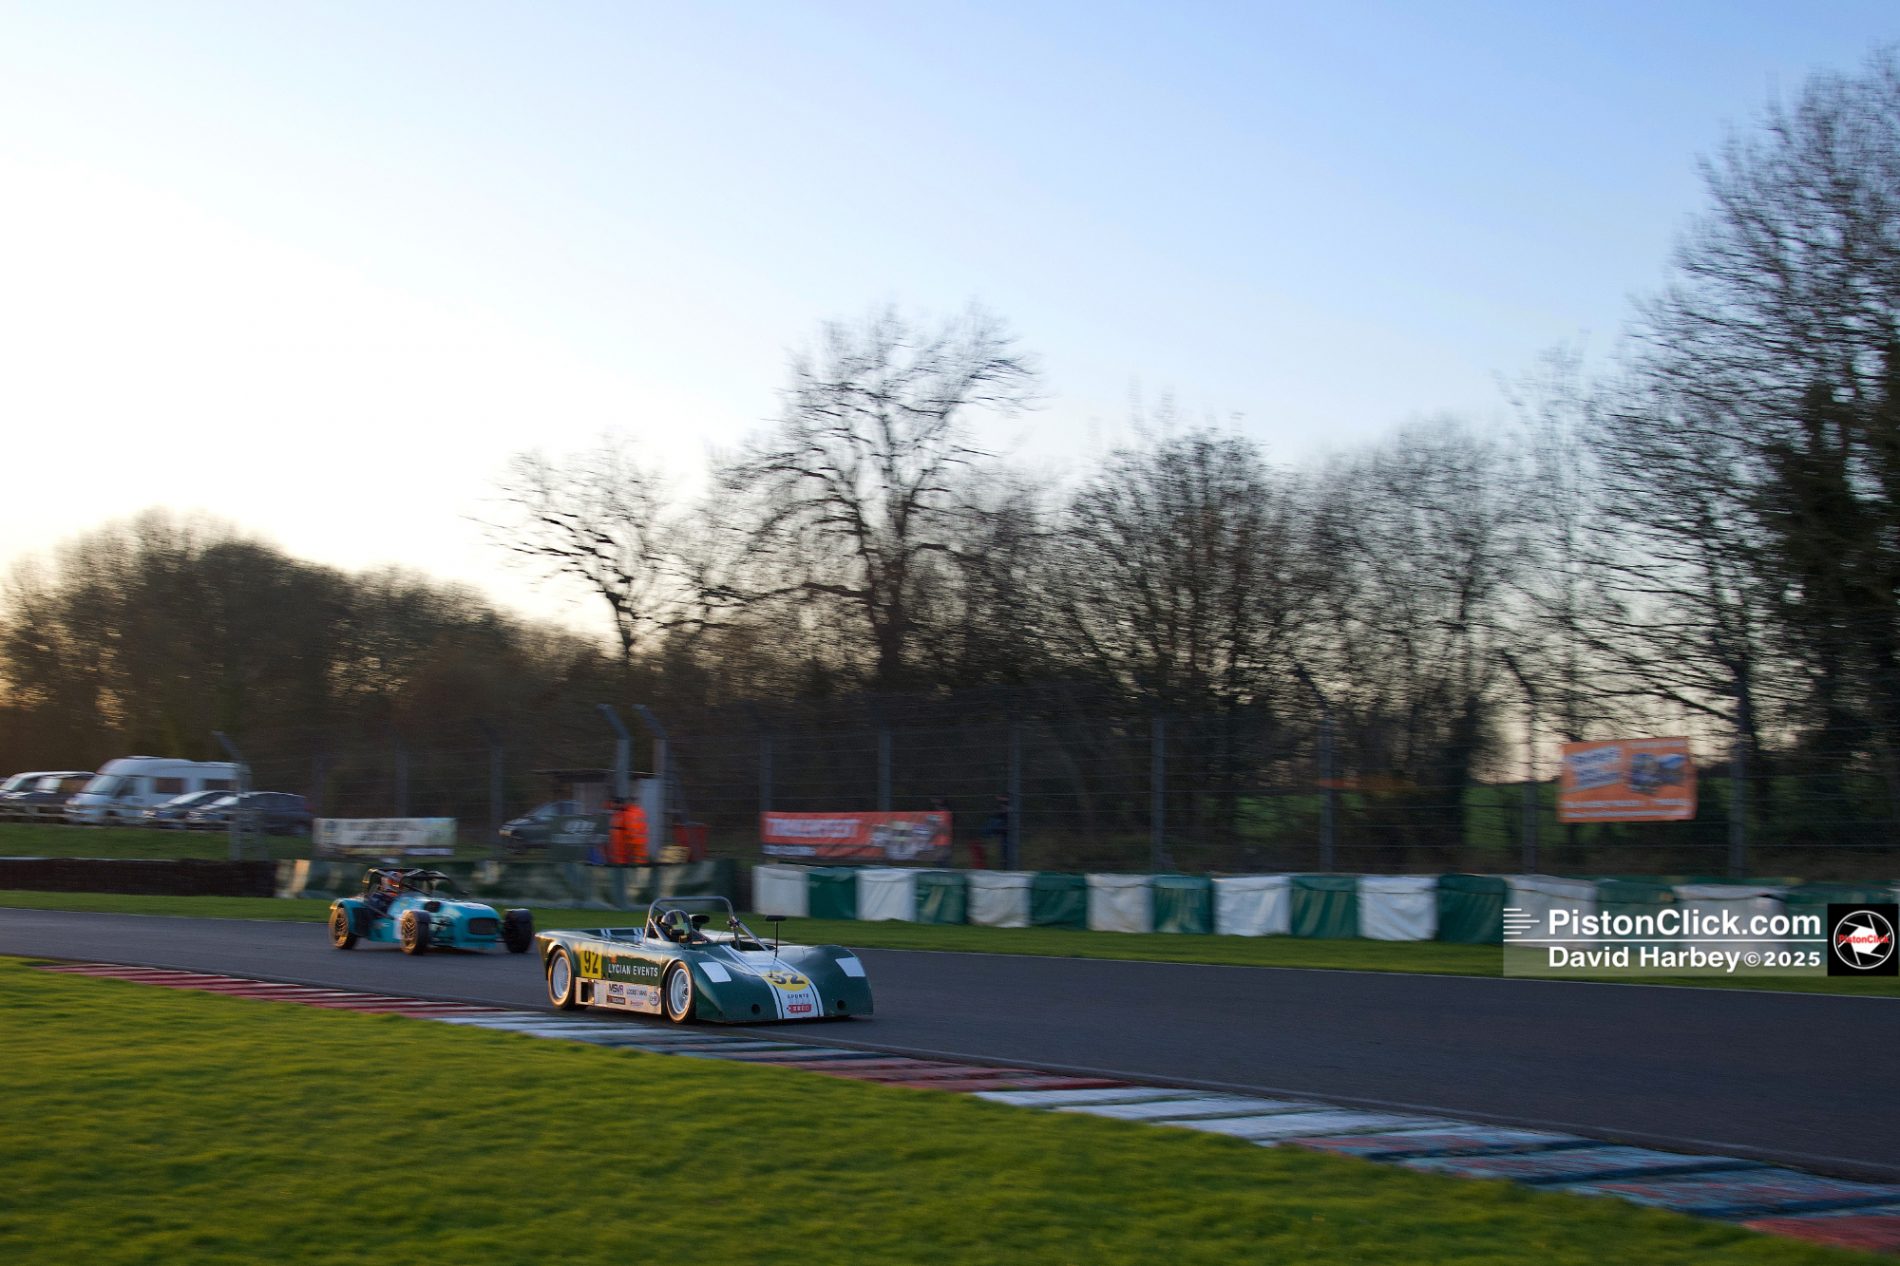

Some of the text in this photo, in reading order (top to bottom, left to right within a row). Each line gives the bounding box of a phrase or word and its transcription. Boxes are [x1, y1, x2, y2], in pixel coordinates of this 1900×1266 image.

[584, 949, 599, 974] 92
[608, 964, 658, 977] LYCIAN EVENTS
